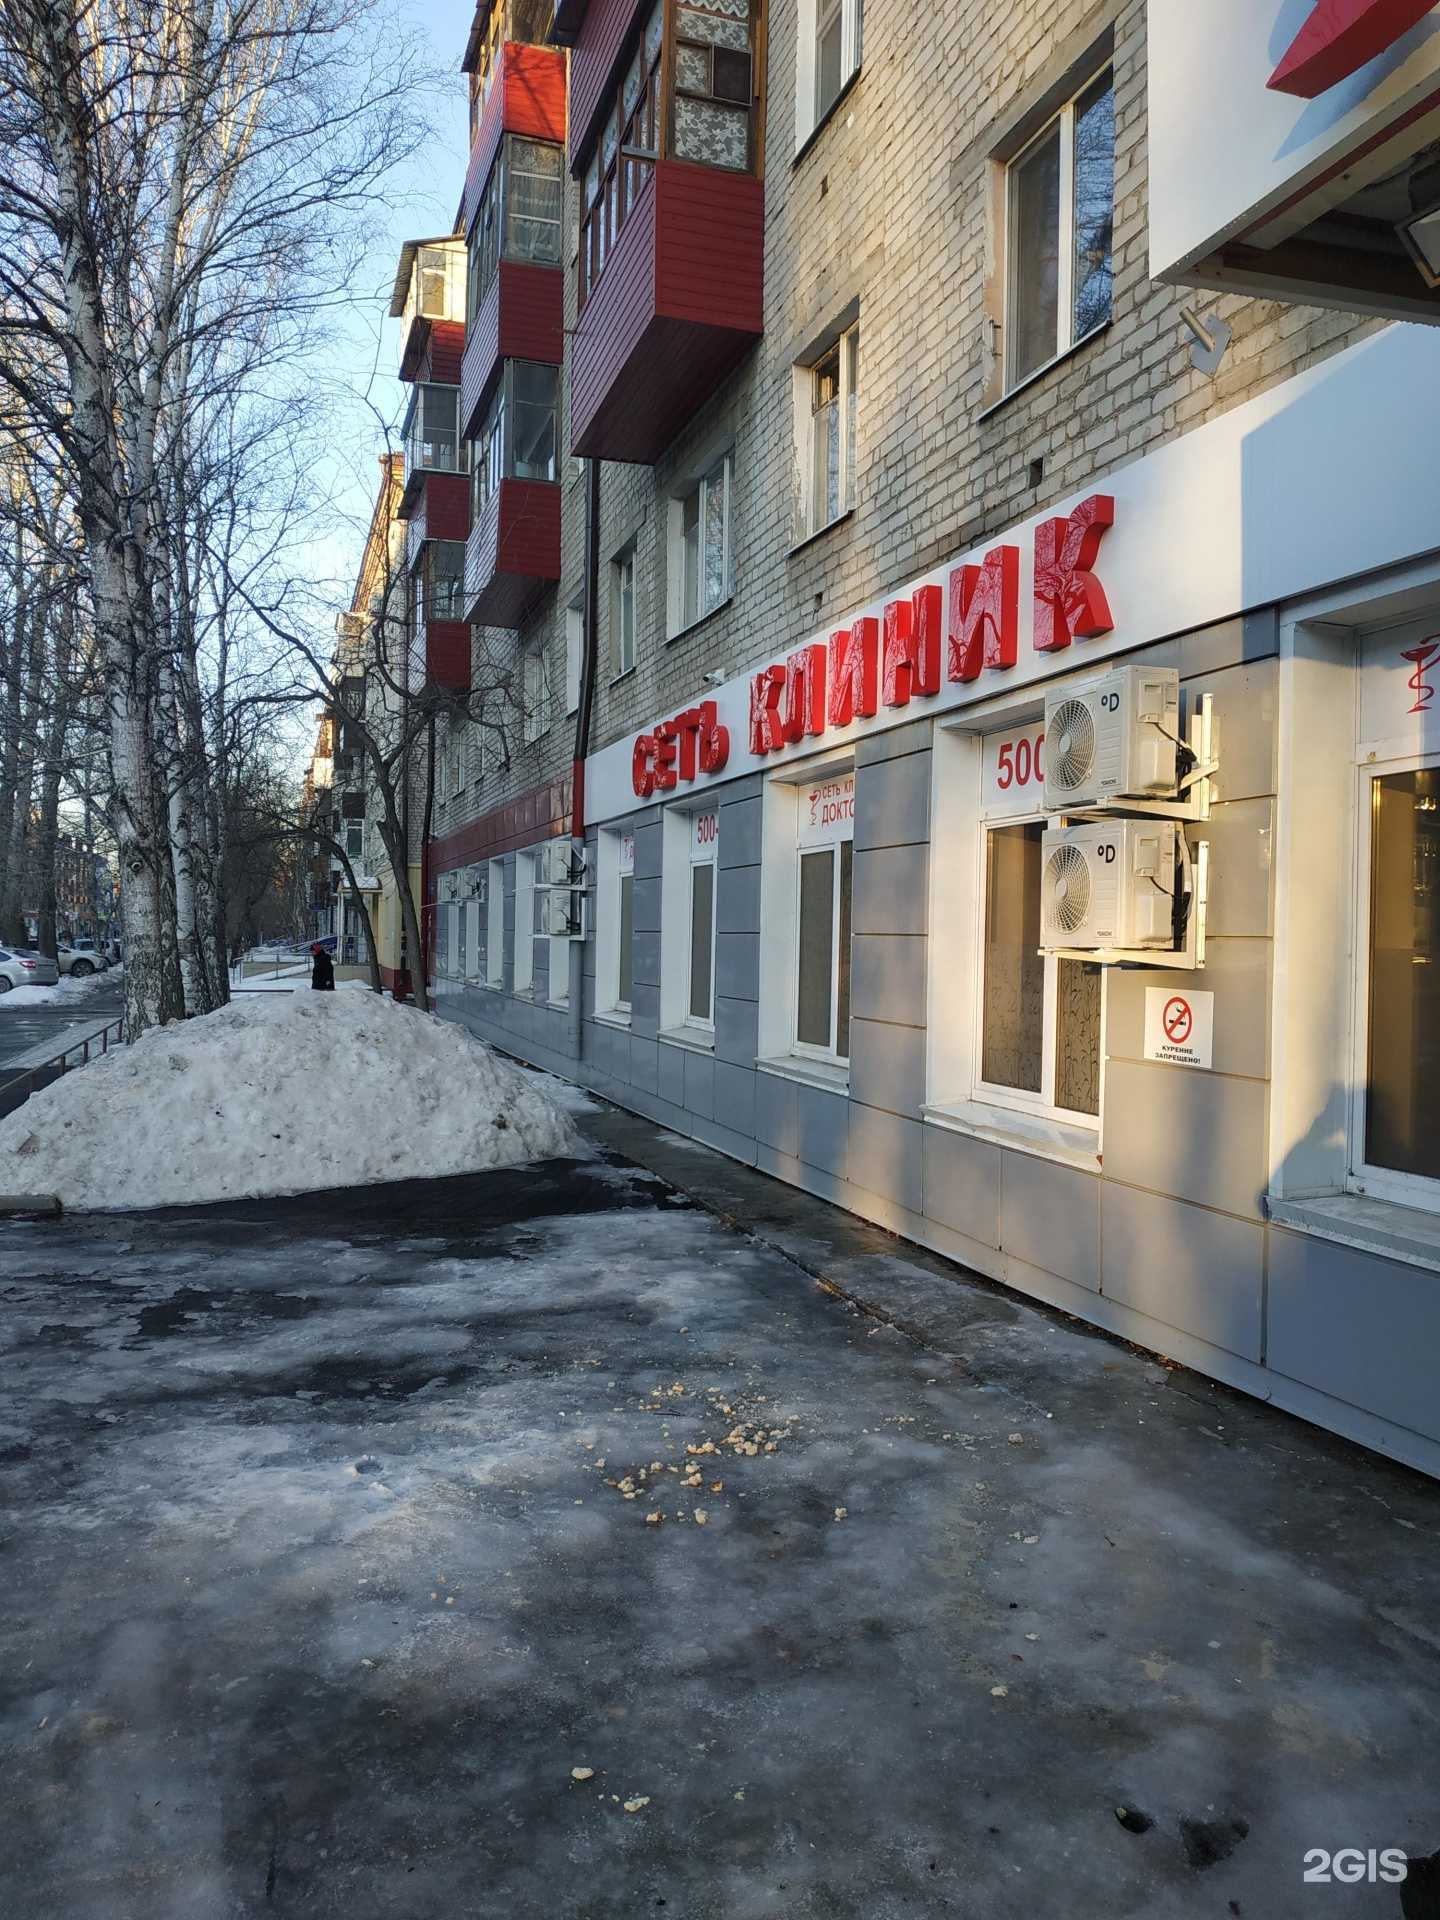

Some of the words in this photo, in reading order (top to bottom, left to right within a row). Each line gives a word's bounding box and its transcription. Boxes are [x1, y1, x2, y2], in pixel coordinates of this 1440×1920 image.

[632, 701, 730, 797] СЕТЬ
[750, 494, 1115, 756] КЛИНИК
[822, 783, 840, 799] СЕТЬ
[1161, 1045, 1193, 1055] КУРЕНИЕ
